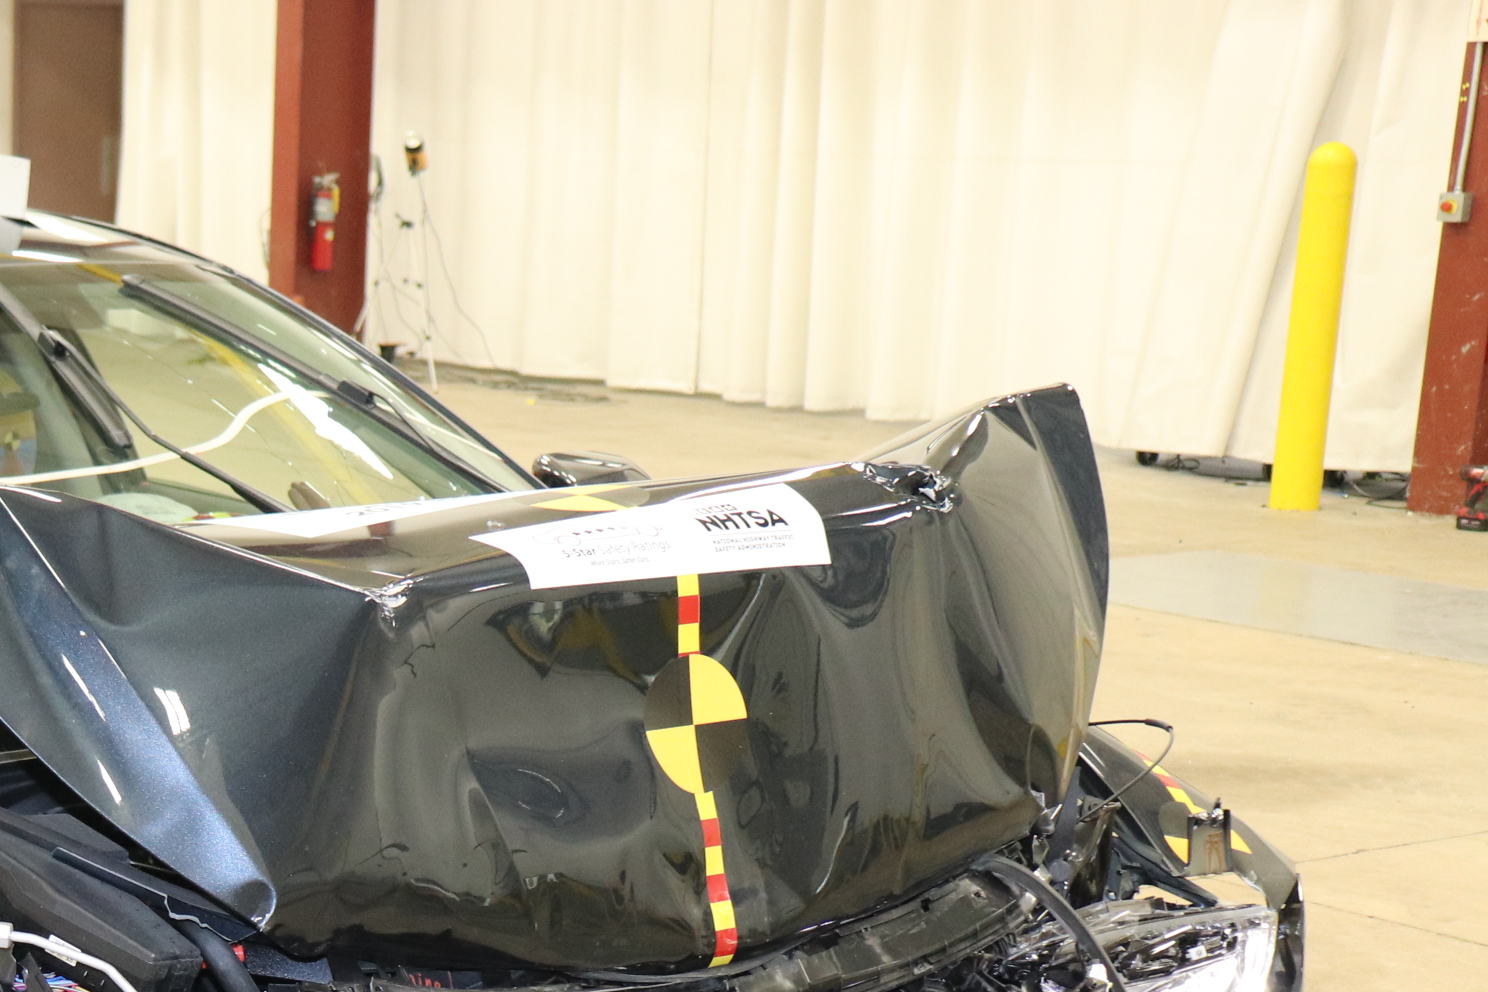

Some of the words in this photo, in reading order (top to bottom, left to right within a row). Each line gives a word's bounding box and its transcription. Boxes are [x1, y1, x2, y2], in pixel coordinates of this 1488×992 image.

[694, 508, 789, 532] NHTSA
[562, 547, 596, 558] 5-Star
[597, 543, 631, 555] Safety
[631, 540, 671, 553] Ratings
